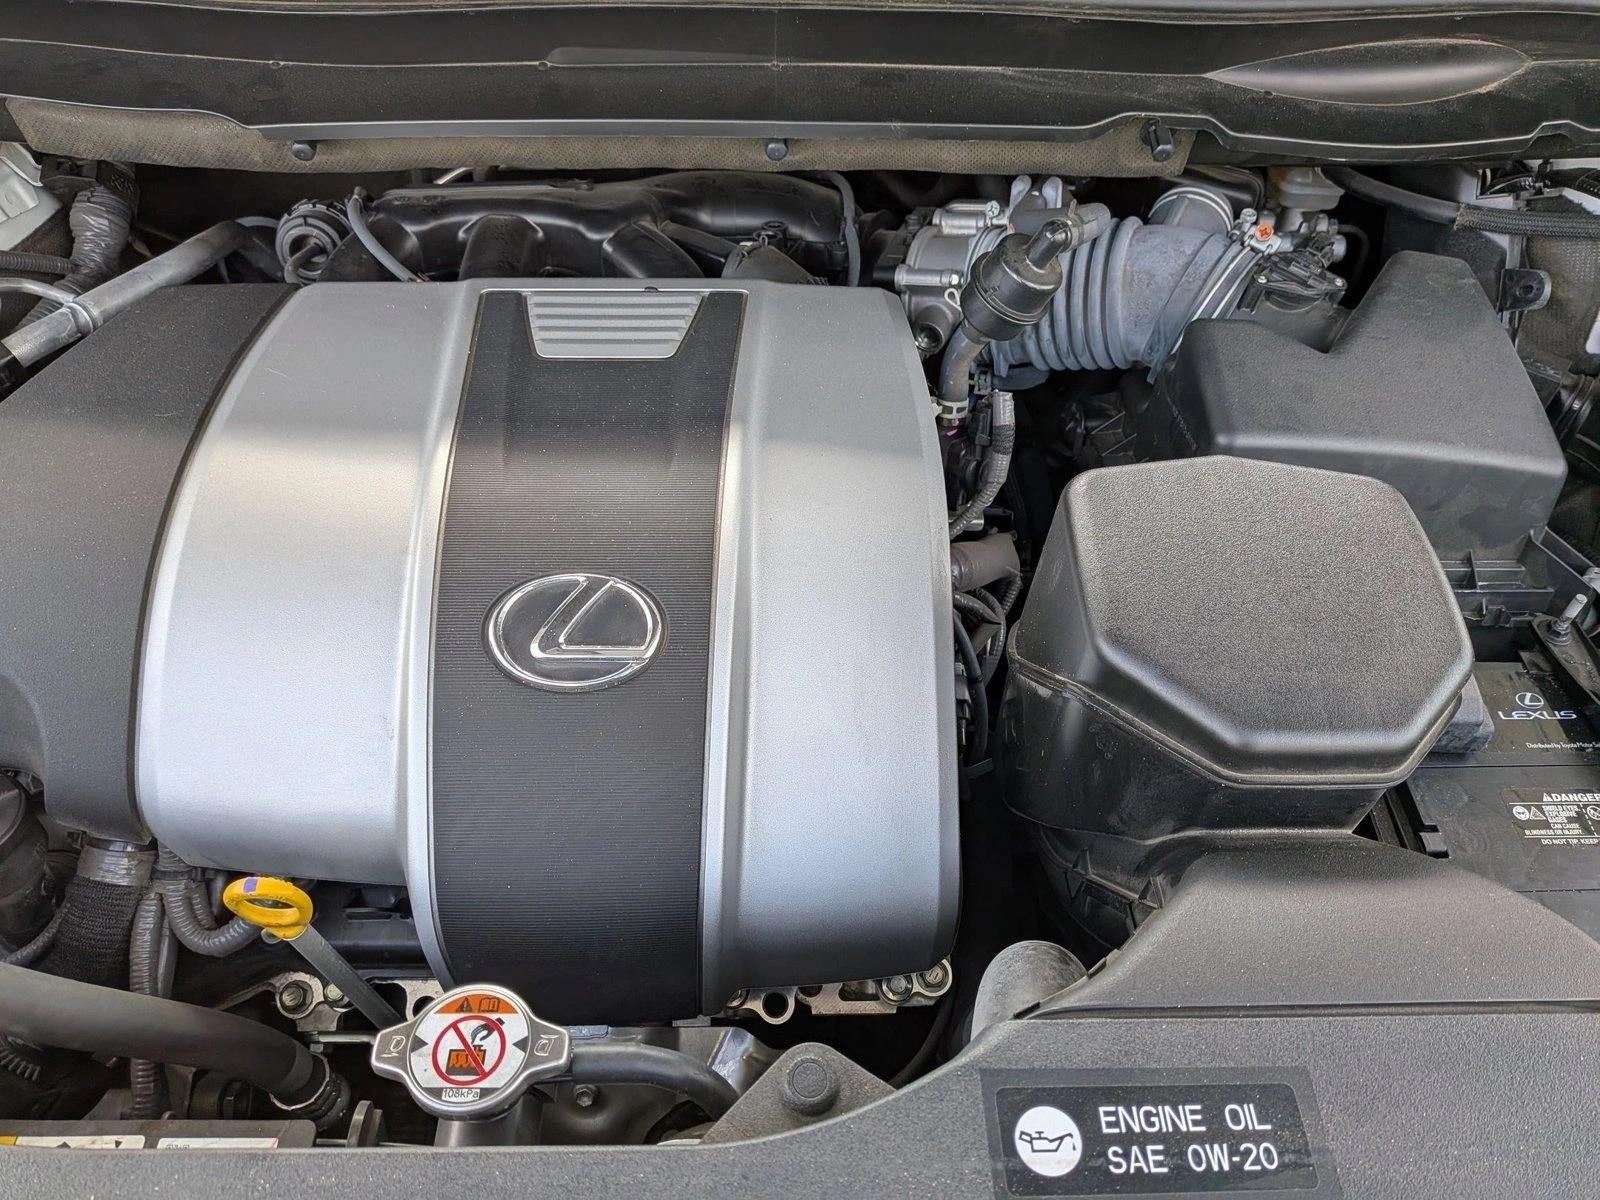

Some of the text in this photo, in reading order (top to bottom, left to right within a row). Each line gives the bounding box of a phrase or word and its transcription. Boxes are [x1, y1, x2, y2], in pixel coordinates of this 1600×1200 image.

[1498, 711, 1577, 719] LEXUS
[443, 1089, 479, 1098] 108kPa
[1098, 1103, 1271, 1133] ENGINE OIL
[1107, 1142, 1278, 1174] SAE 0W-20
